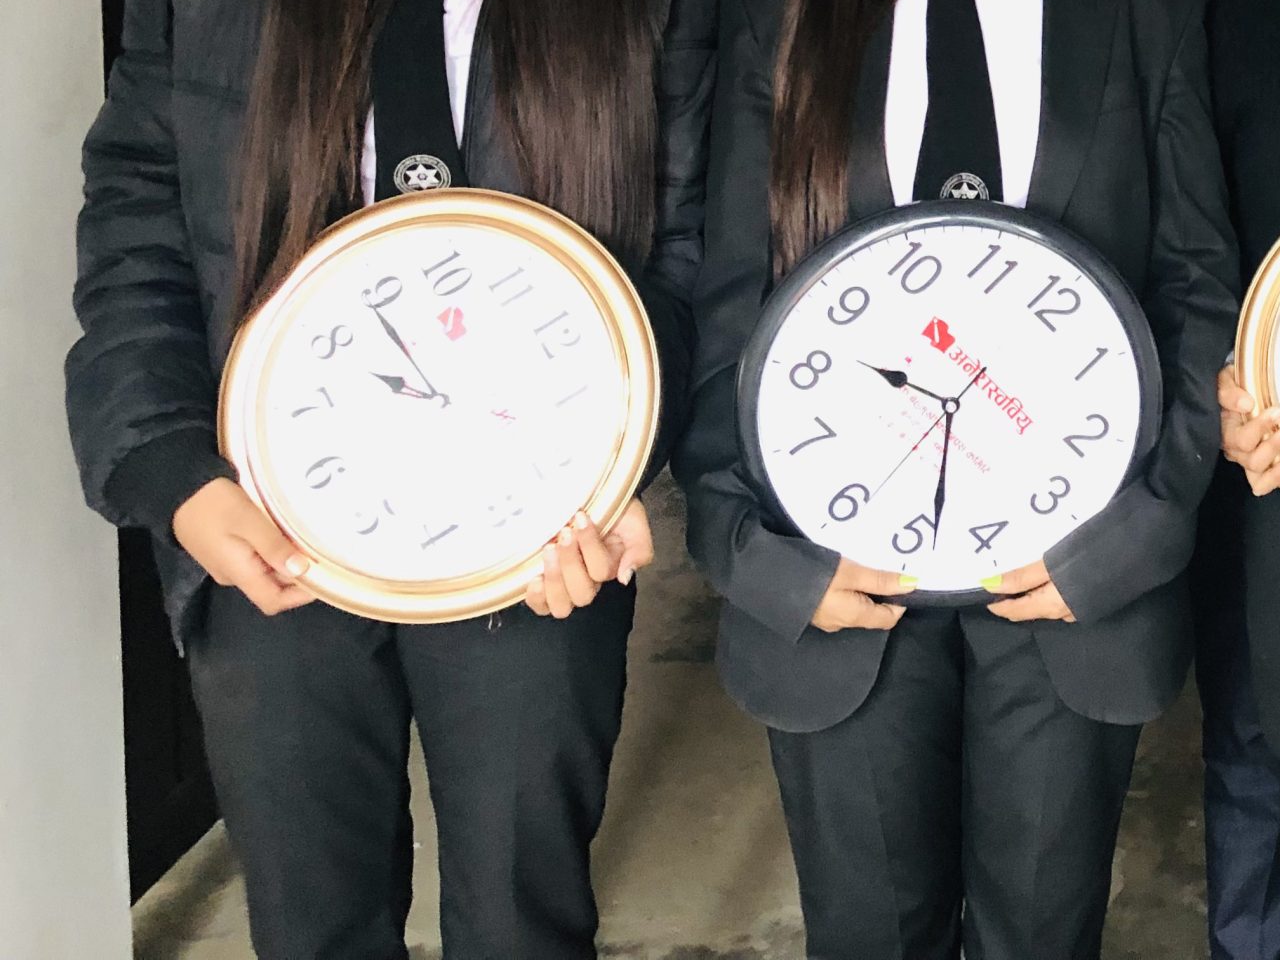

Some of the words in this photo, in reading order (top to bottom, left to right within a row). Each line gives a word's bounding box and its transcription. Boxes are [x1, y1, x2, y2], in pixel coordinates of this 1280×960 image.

[421, 249, 473, 297] 10
[488, 266, 534, 307] 11
[887, 241, 942, 295] 10
[967, 244, 1018, 294] 11
[360, 275, 403, 310] 9
[827, 285, 870, 326] 9
[1026, 274, 1082, 333] 12
[310, 324, 354, 360] 8
[789, 349, 832, 390] 8
[1074, 346, 1110, 382] 1
[789, 416, 837, 456] 7
[1062, 414, 1110, 458] 2
[304, 455, 346, 490] 6
[828, 483, 871, 522] 6
[1030, 475, 1071, 515] 3
[892, 514, 936, 554] 5
[968, 520, 1010, 554] 4
